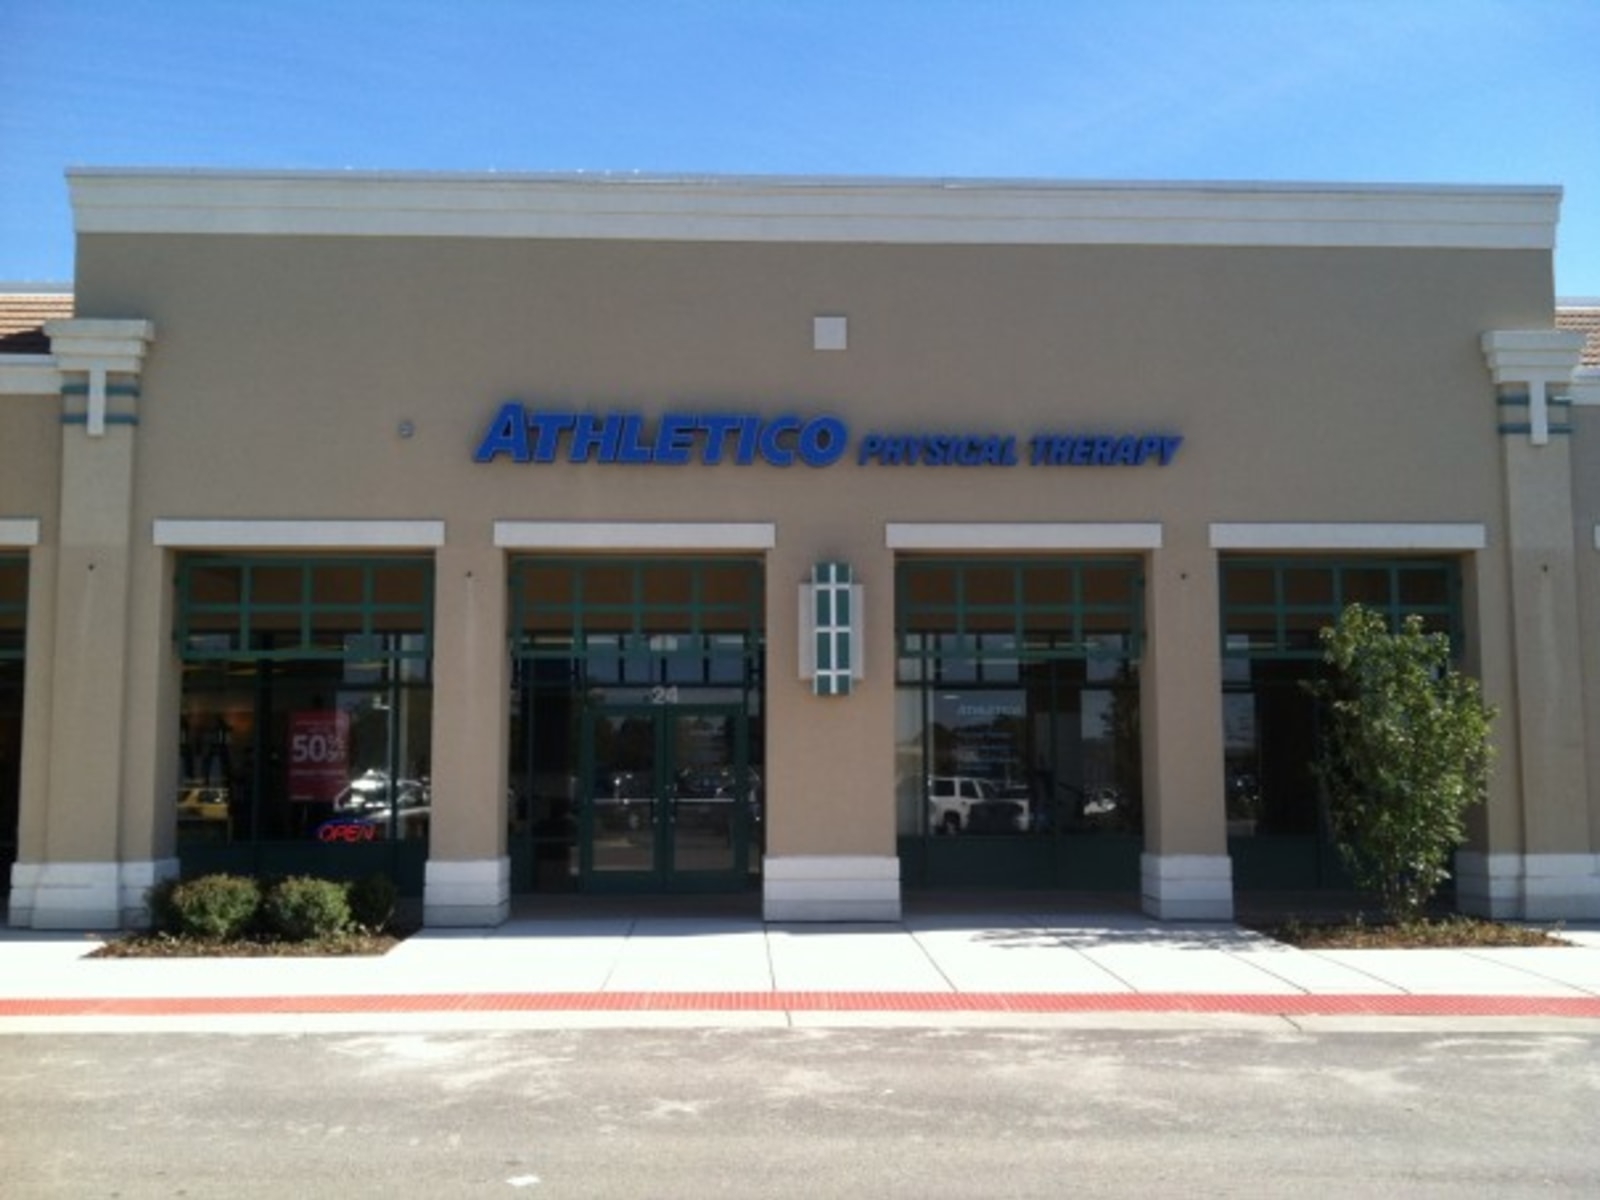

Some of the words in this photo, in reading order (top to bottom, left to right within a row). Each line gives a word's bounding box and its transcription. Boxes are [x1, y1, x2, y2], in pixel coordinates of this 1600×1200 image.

[474, 402, 848, 465] ATHLETICO
[858, 434, 1018, 466] PHYSICAL
[1029, 435, 1183, 465] THERAPY
[652, 686, 679, 704] 24
[319, 824, 376, 842] OPEN
